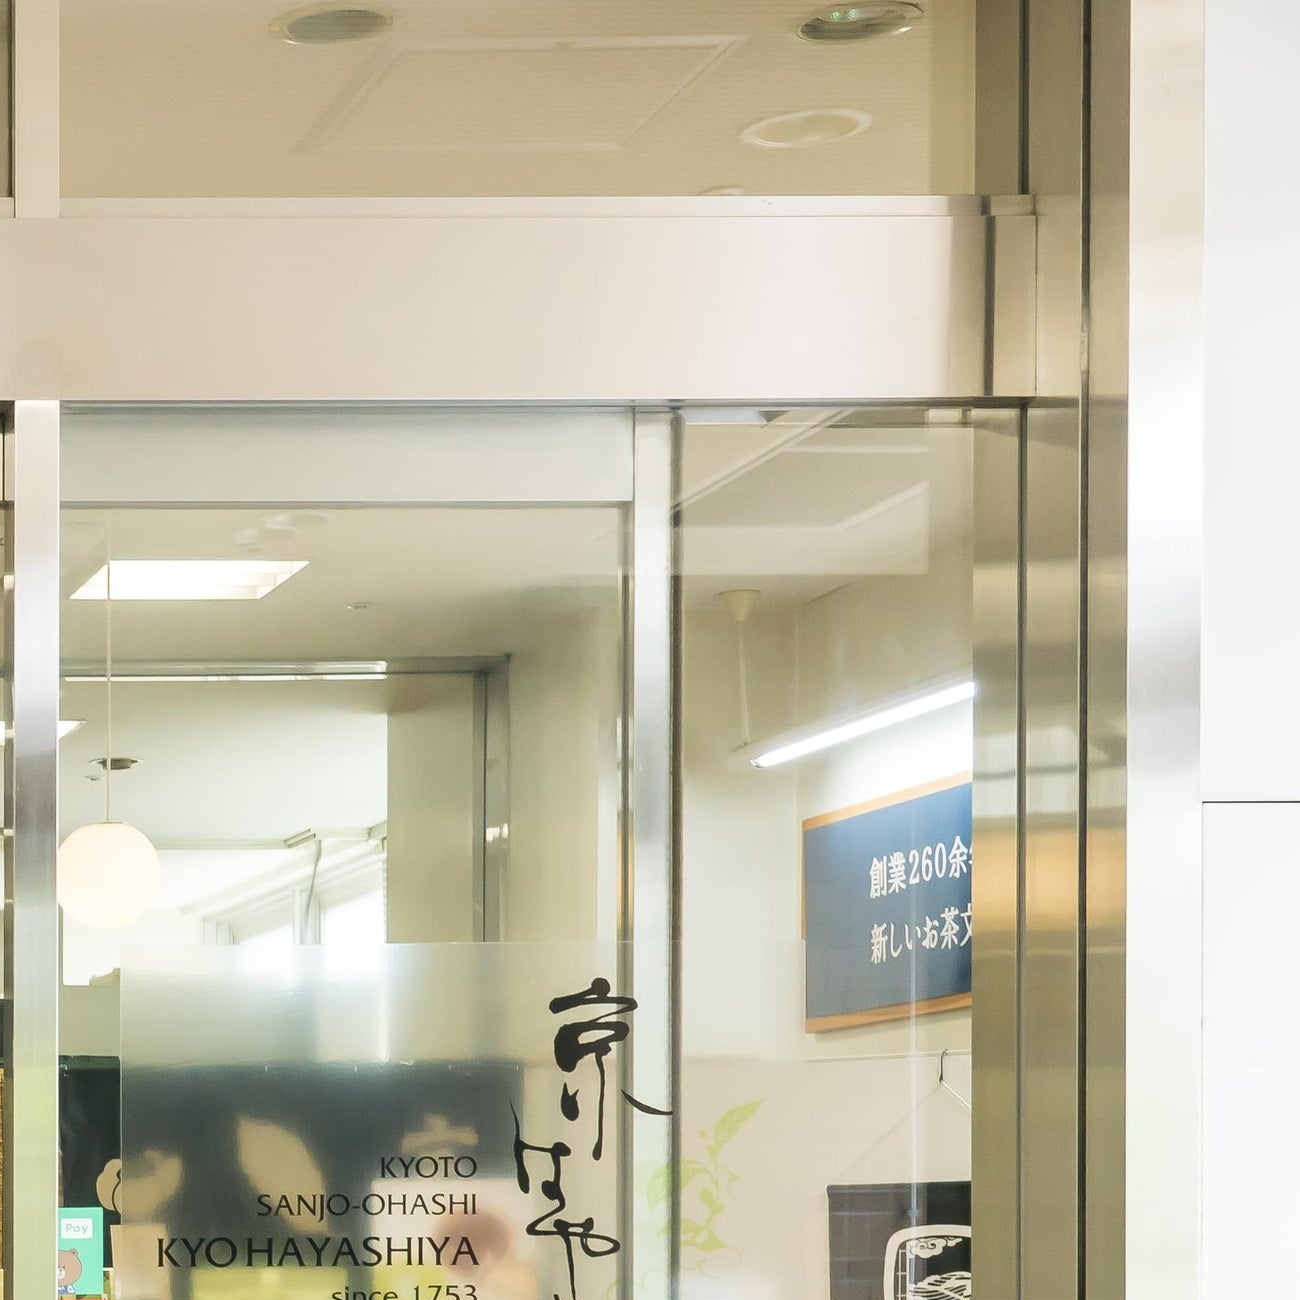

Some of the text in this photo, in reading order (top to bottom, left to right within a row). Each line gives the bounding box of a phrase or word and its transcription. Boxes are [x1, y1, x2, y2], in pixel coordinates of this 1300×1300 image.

[868, 834, 972, 899] 創業260余
[380, 1155, 478, 1179] KYOTO
[256, 1193, 478, 1223] SANJO-OHASHI
[65, 1222, 89, 1235] Pay
